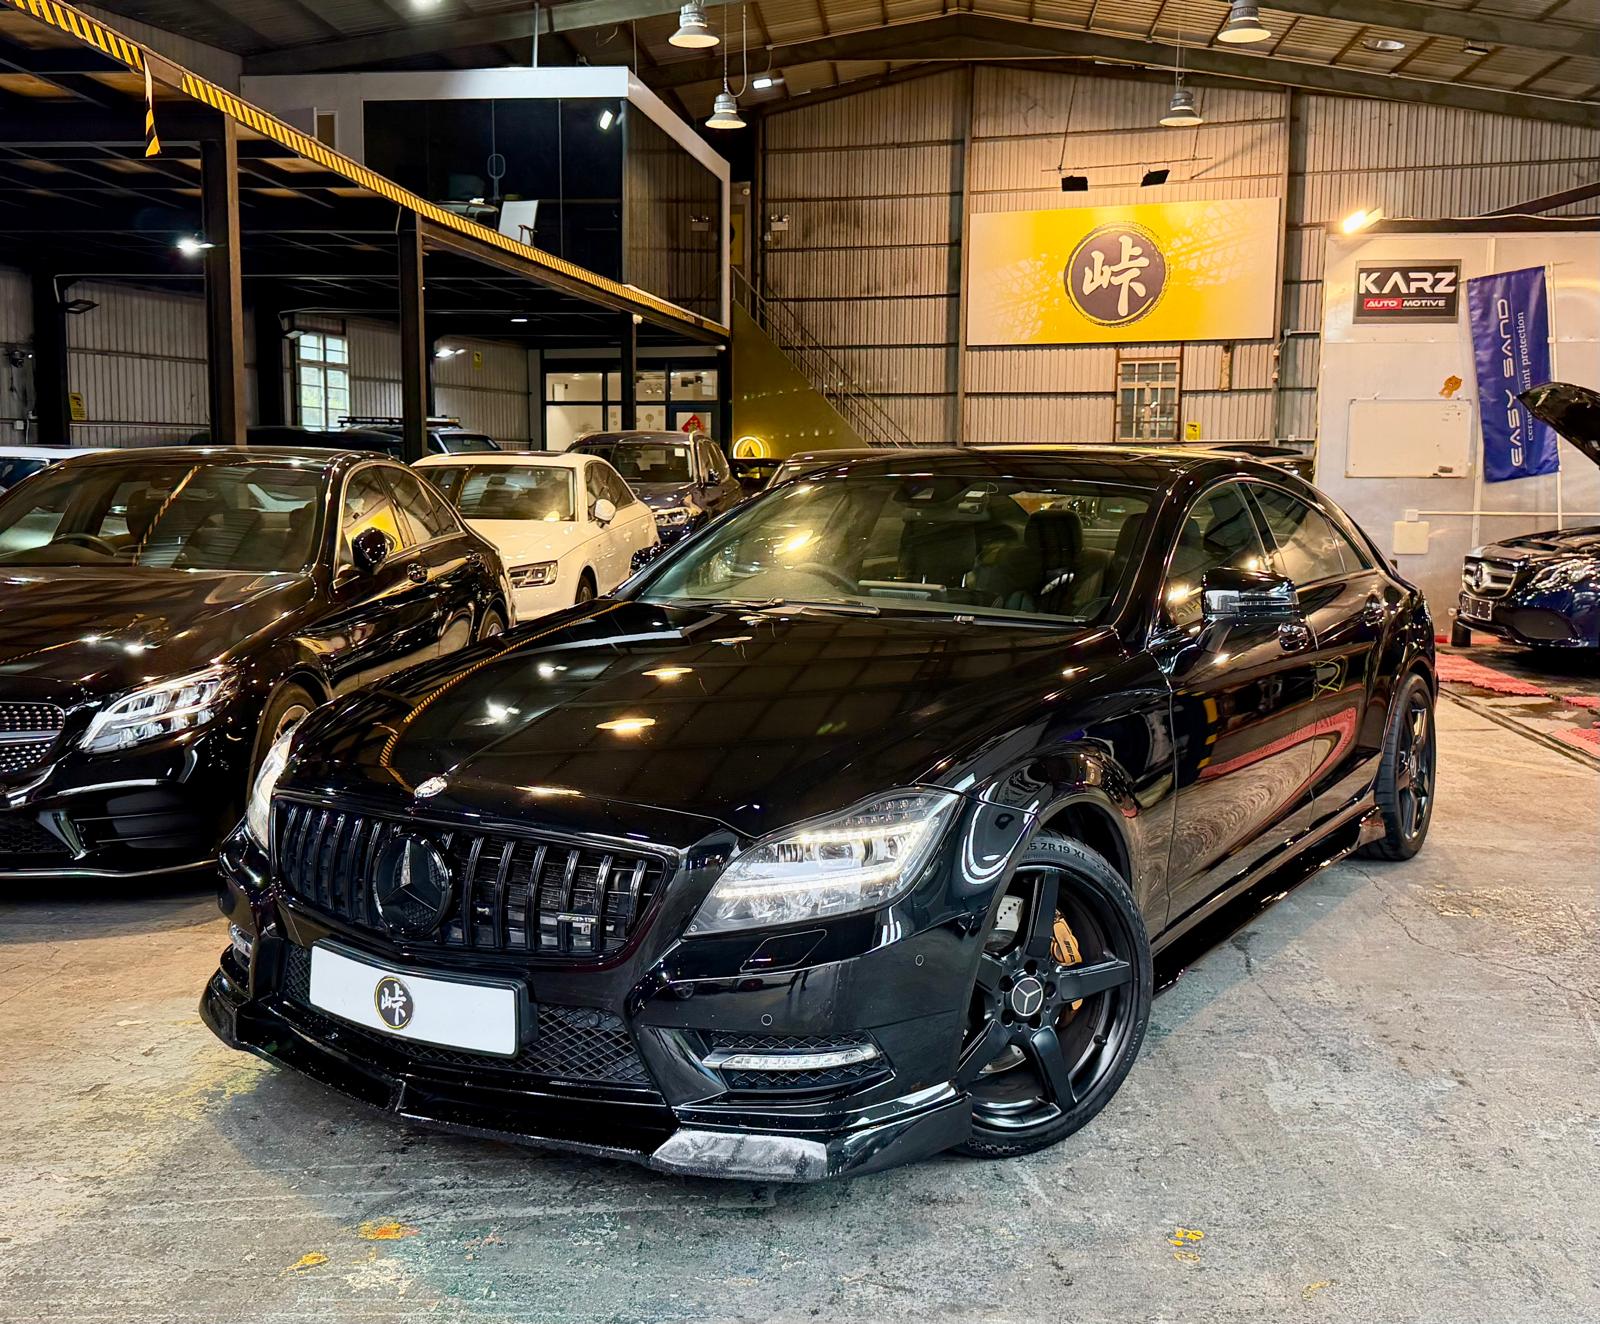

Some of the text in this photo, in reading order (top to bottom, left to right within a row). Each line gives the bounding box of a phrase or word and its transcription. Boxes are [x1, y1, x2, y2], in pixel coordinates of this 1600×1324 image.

[1082, 235, 1150, 317] 峠
[1359, 271, 1457, 294] KARZ
[1366, 299, 1446, 308] AUTO MOTIVE
[1517, 311, 1532, 367] protection
[1497, 299, 1523, 466] EASY SAND
[381, 983, 407, 1026] 峠
